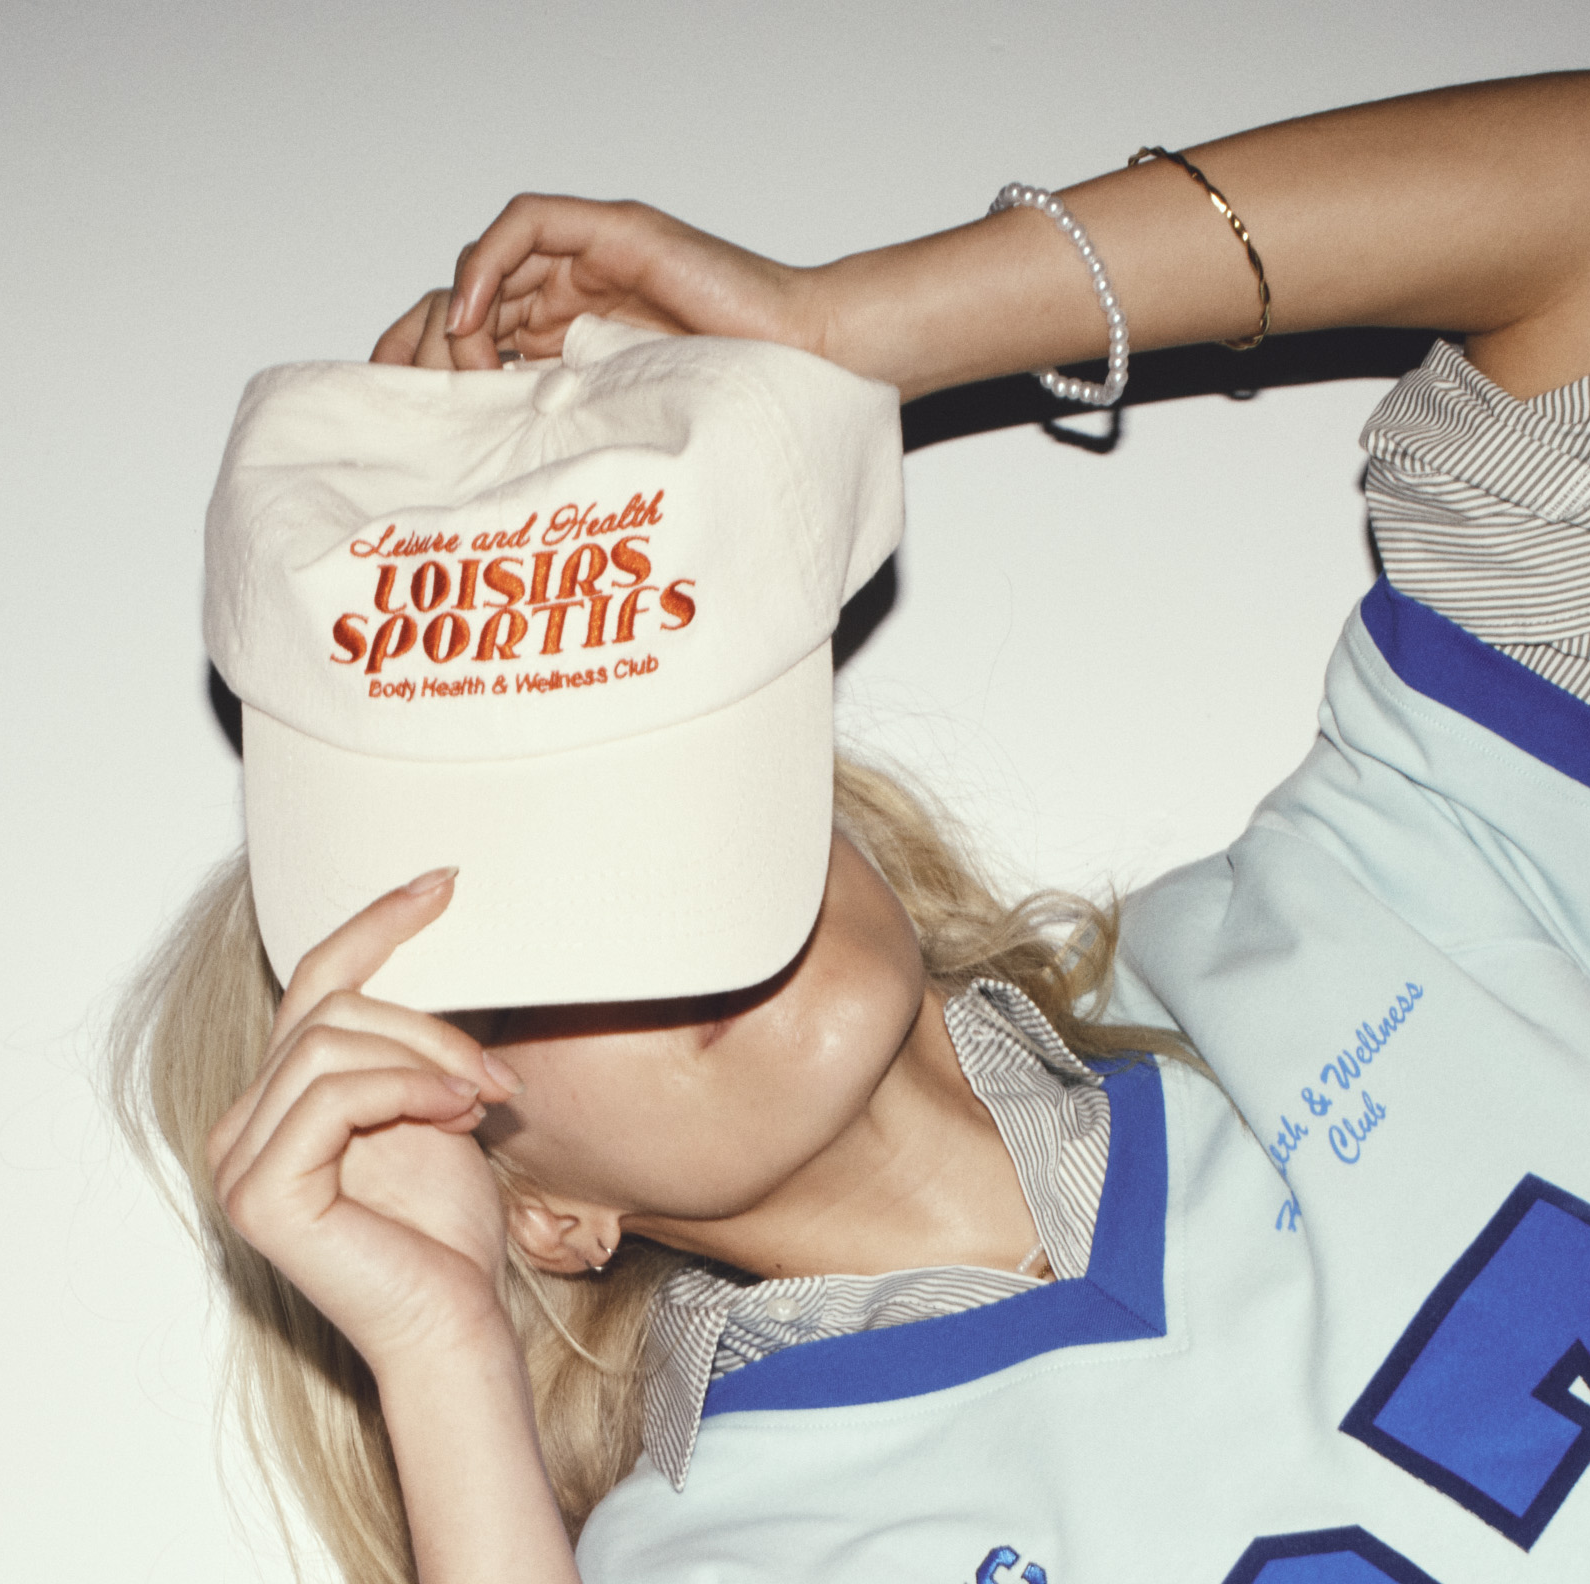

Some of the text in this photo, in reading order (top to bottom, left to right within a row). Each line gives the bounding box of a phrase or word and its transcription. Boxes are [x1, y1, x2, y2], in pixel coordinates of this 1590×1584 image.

[349, 489, 665, 558] Leisure and Health
[373, 535, 652, 614] LOISIRS
[329, 578, 697, 676] SPORTIFS
[368, 654, 659, 702] Body Health & Wellness Club
[1301, 1087, 1333, 1116] &
[1320, 982, 1424, 1090] Wellness
[1328, 1090, 1386, 1164] Club
